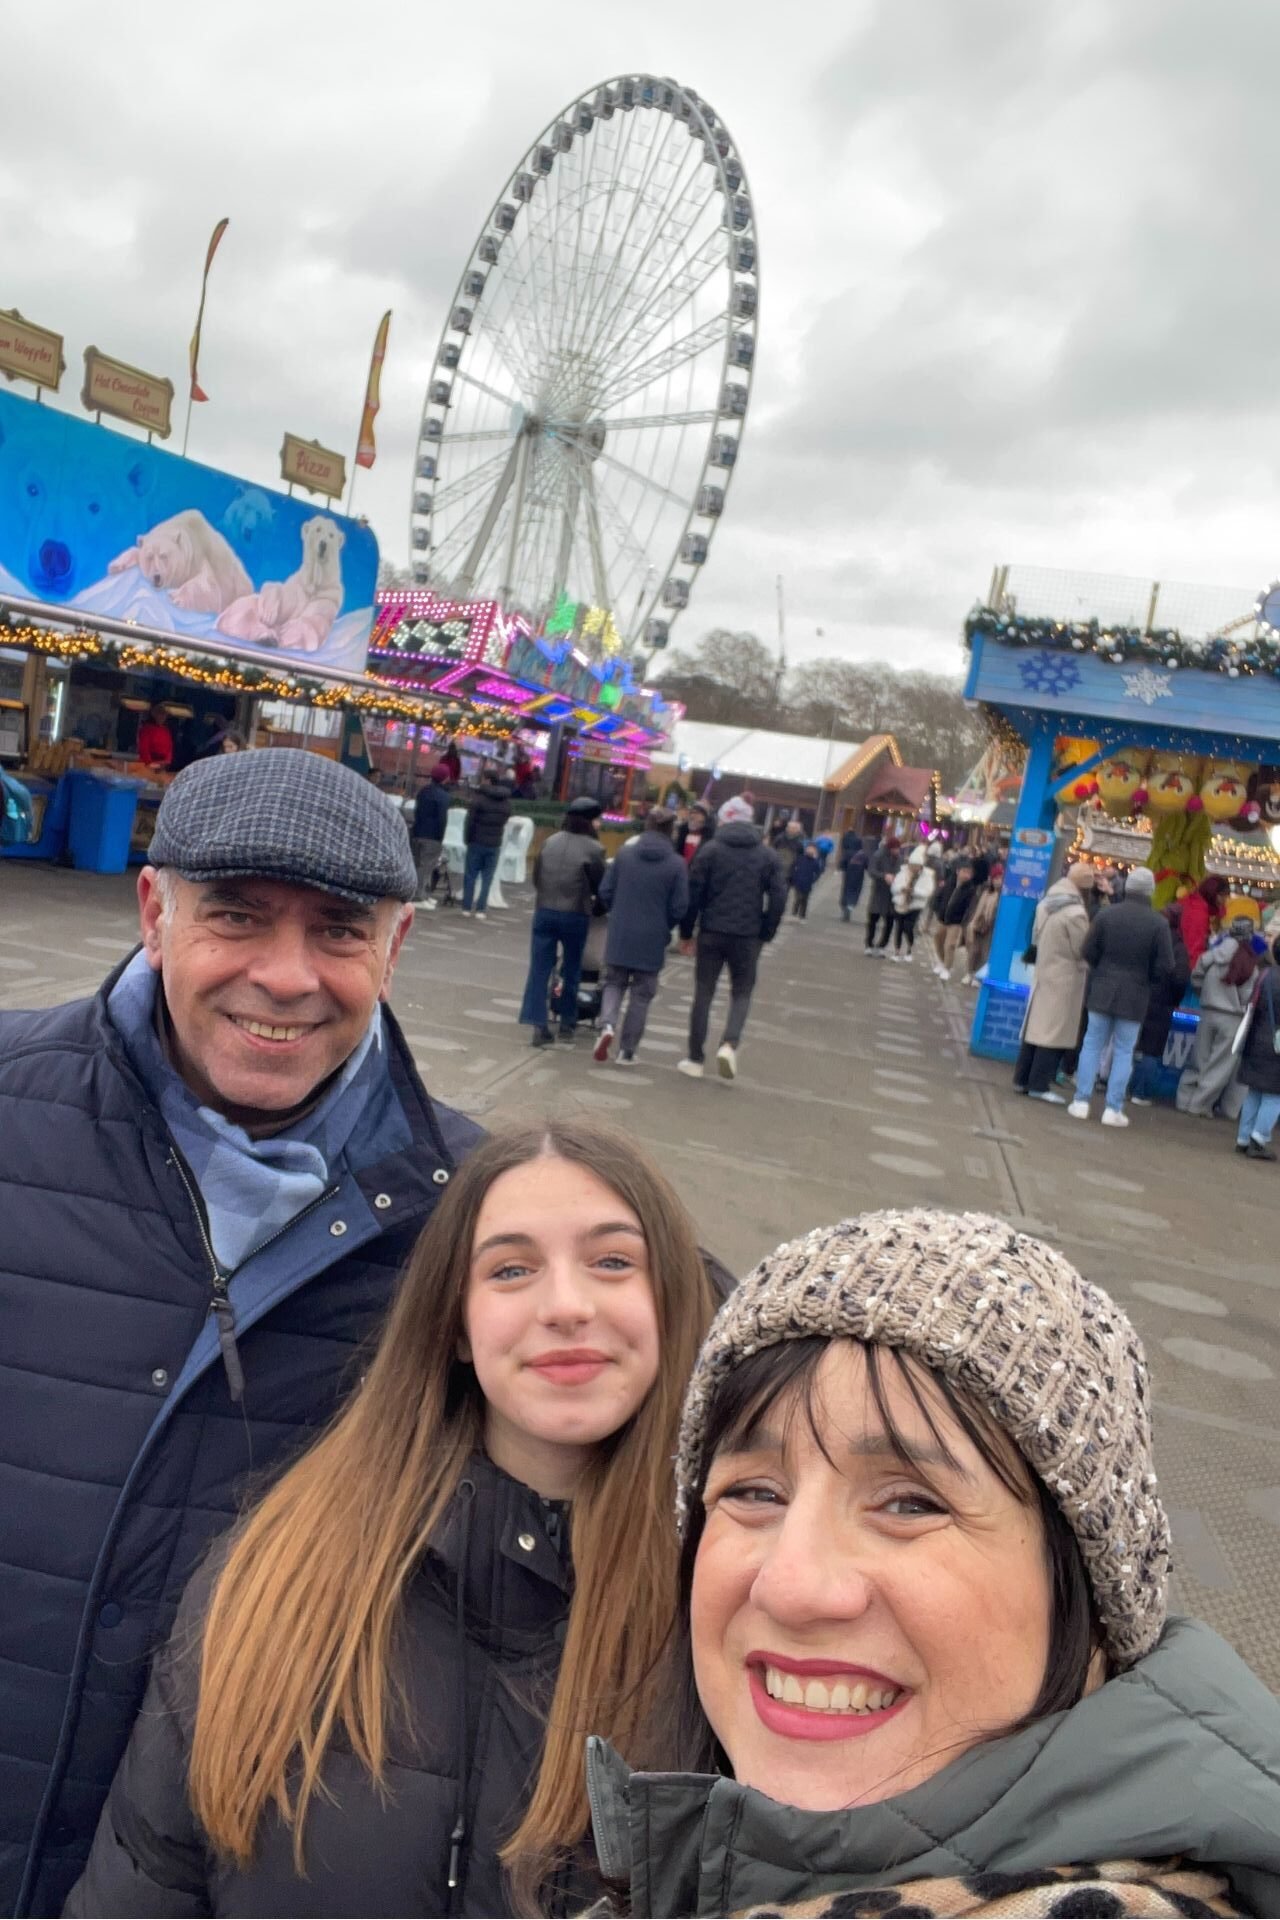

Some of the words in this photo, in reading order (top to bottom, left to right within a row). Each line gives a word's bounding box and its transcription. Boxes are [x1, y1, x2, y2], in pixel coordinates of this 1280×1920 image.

[14, 337, 53, 363] Waffles
[95, 373, 111, 389] Hot
[296, 448, 332, 478] Pizza
